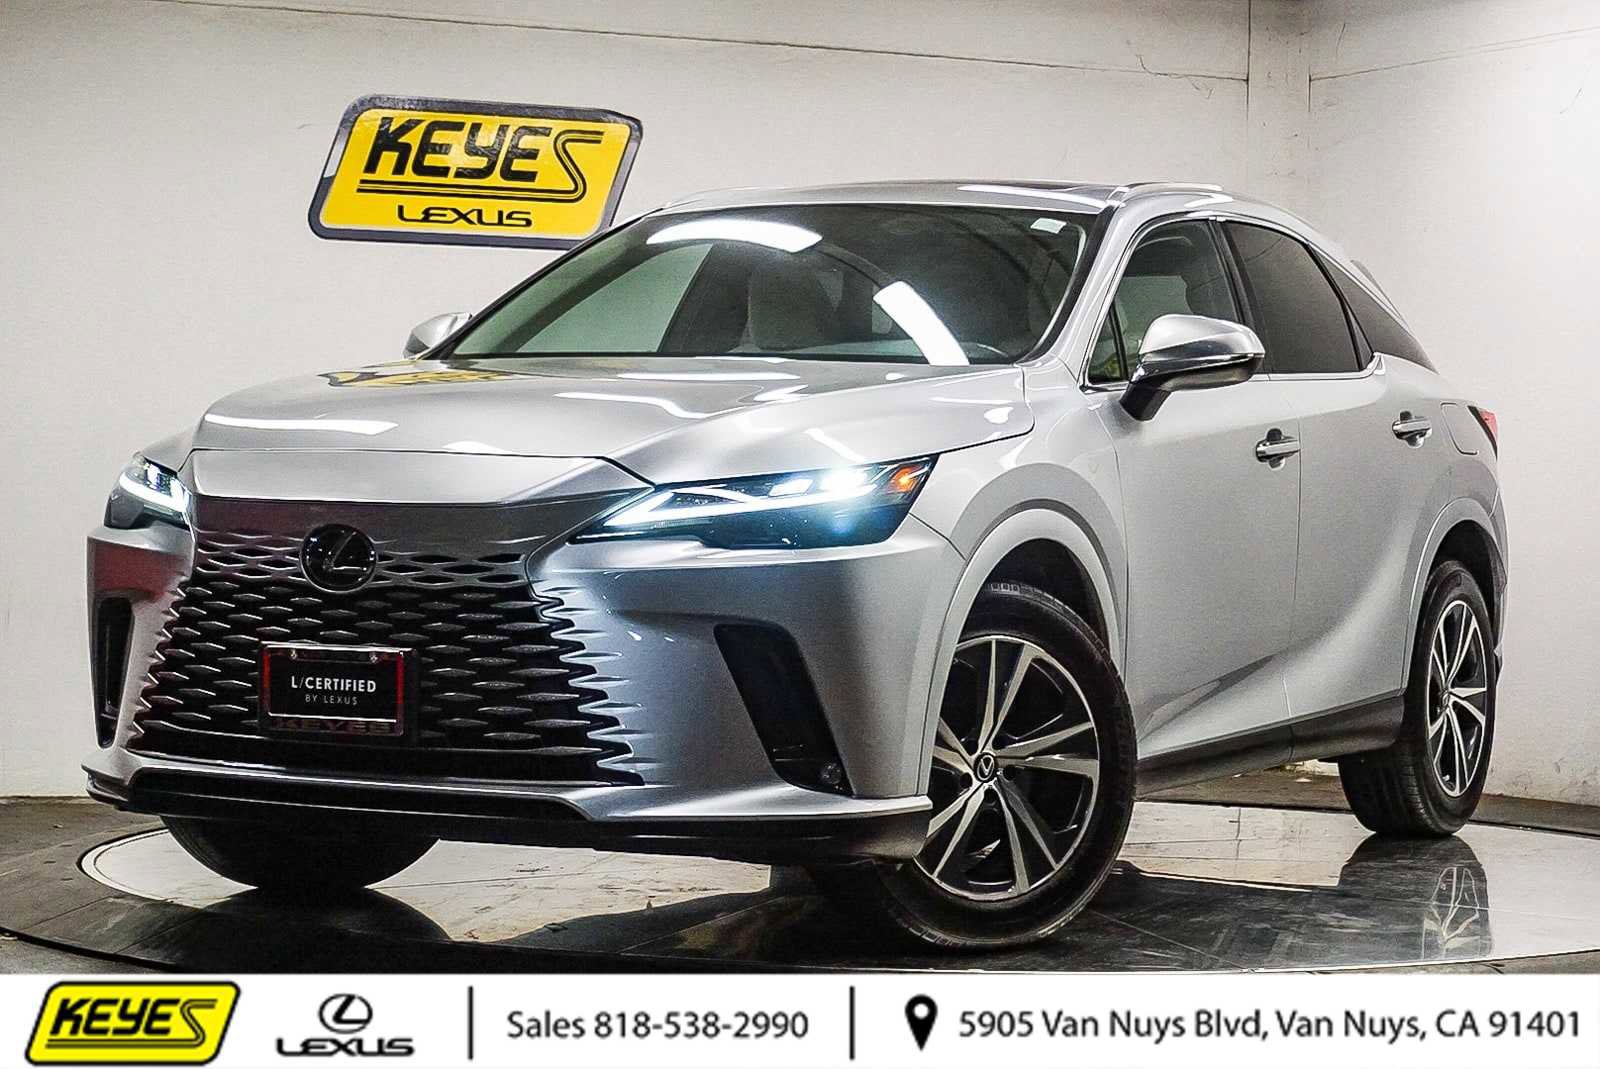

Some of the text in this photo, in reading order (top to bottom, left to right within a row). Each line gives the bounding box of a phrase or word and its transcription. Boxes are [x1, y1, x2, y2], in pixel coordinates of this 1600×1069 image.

[358, 116, 604, 203] KEYES
[397, 204, 532, 228] LEXUS
[291, 675, 377, 693] L/CERTIFIED
[304, 694, 358, 706] BY LEXUS
